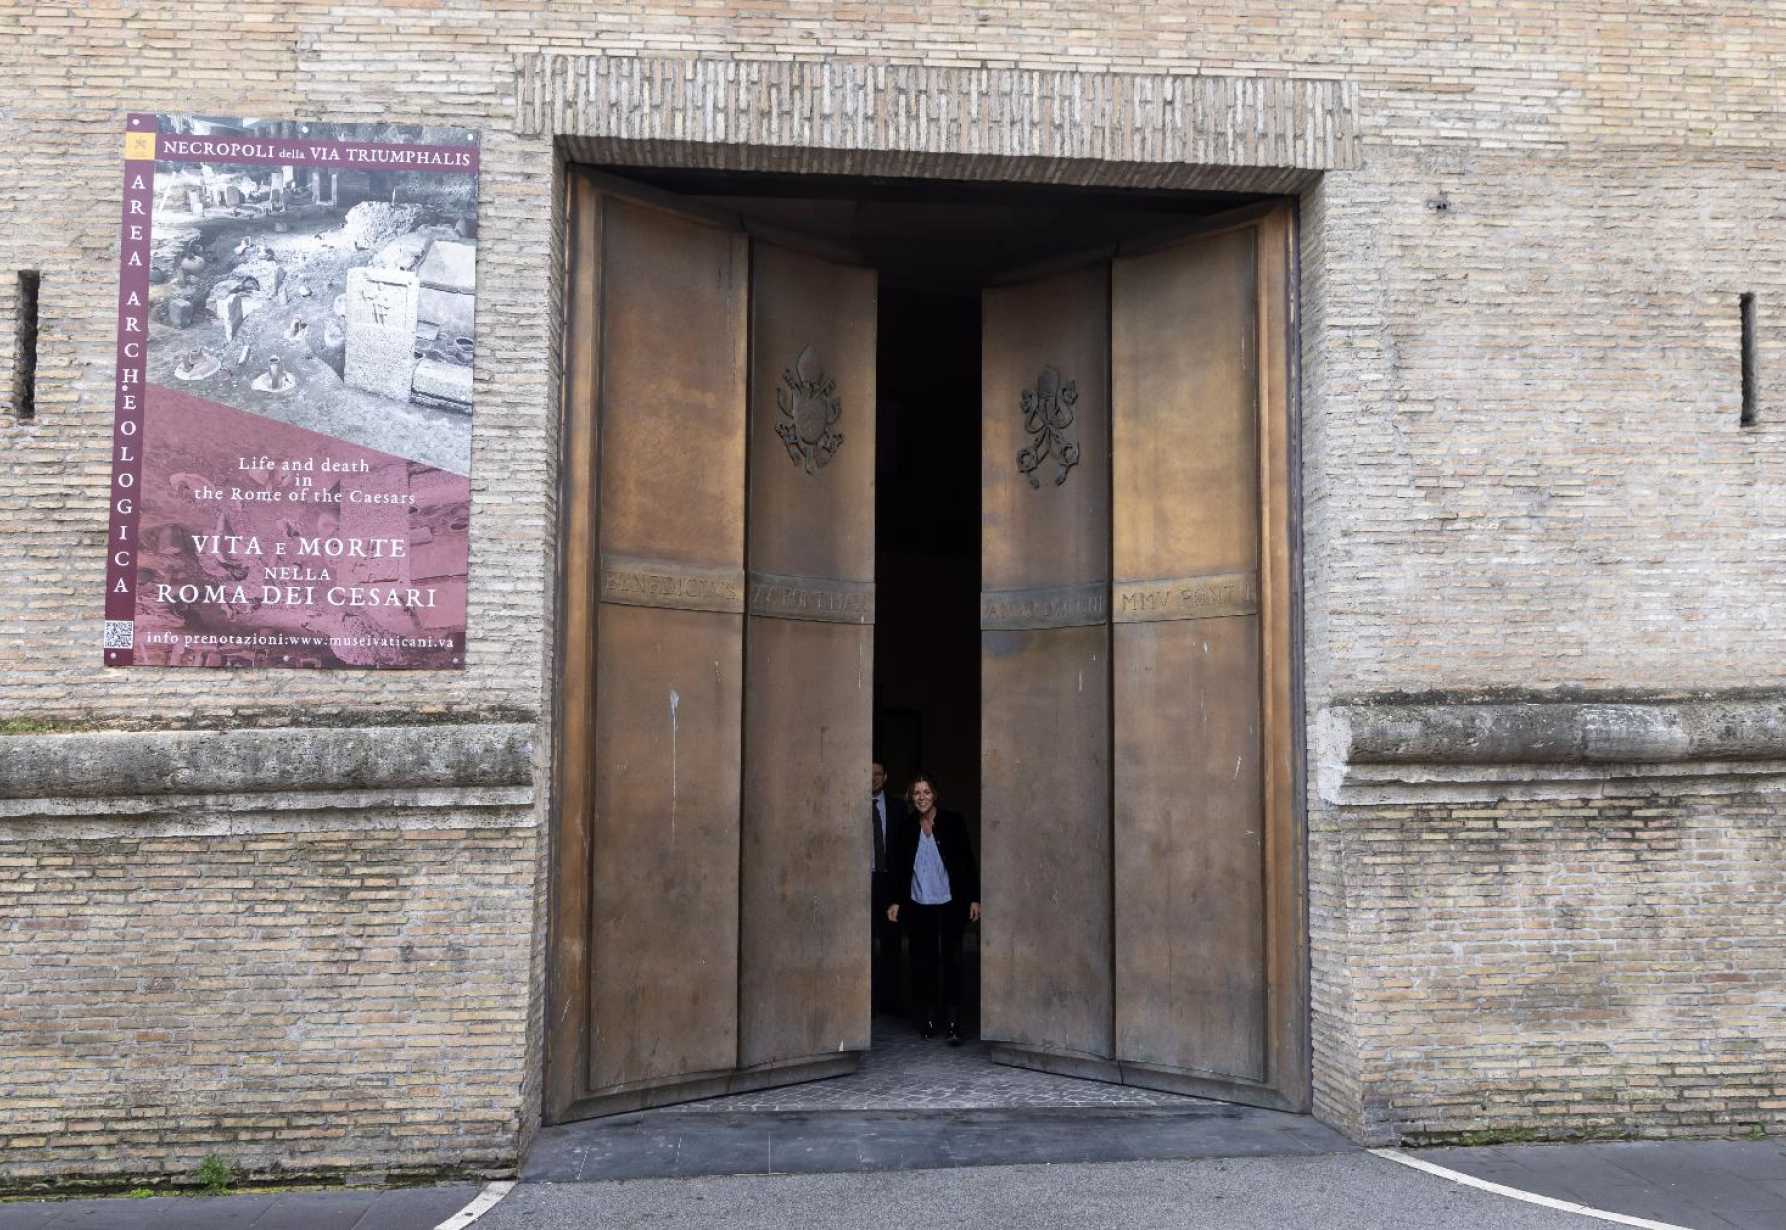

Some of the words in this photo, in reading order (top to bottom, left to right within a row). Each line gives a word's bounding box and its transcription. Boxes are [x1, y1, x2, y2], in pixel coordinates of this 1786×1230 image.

[163, 141, 274, 158] NECROPOLI
[278, 147, 305, 159] della
[310, 147, 340, 160] VIA
[345, 149, 471, 166] TRIUMPHALIS
[128, 174, 146, 267] AREA
[113, 290, 141, 594] ARCHEOLOGICA
[238, 456, 275, 470] Life
[281, 457, 313, 471] and
[321, 457, 369, 473] death
[295, 473, 312, 487] in
[193, 485, 224, 500] the
[231, 487, 282, 502] Rome
[288, 487, 309, 502] of
[313, 487, 342, 503] the
[349, 490, 416, 505] Caesars
[191, 535, 264, 555] VITA
[275, 542, 287, 555] E
[295, 537, 406, 558] MORTE
[264, 567, 330, 581] NELLA
[156, 583, 250, 604] ROMA
[261, 585, 315, 605] DEI
[327, 585, 437, 608] CESARI
[146, 631, 179, 644] info
